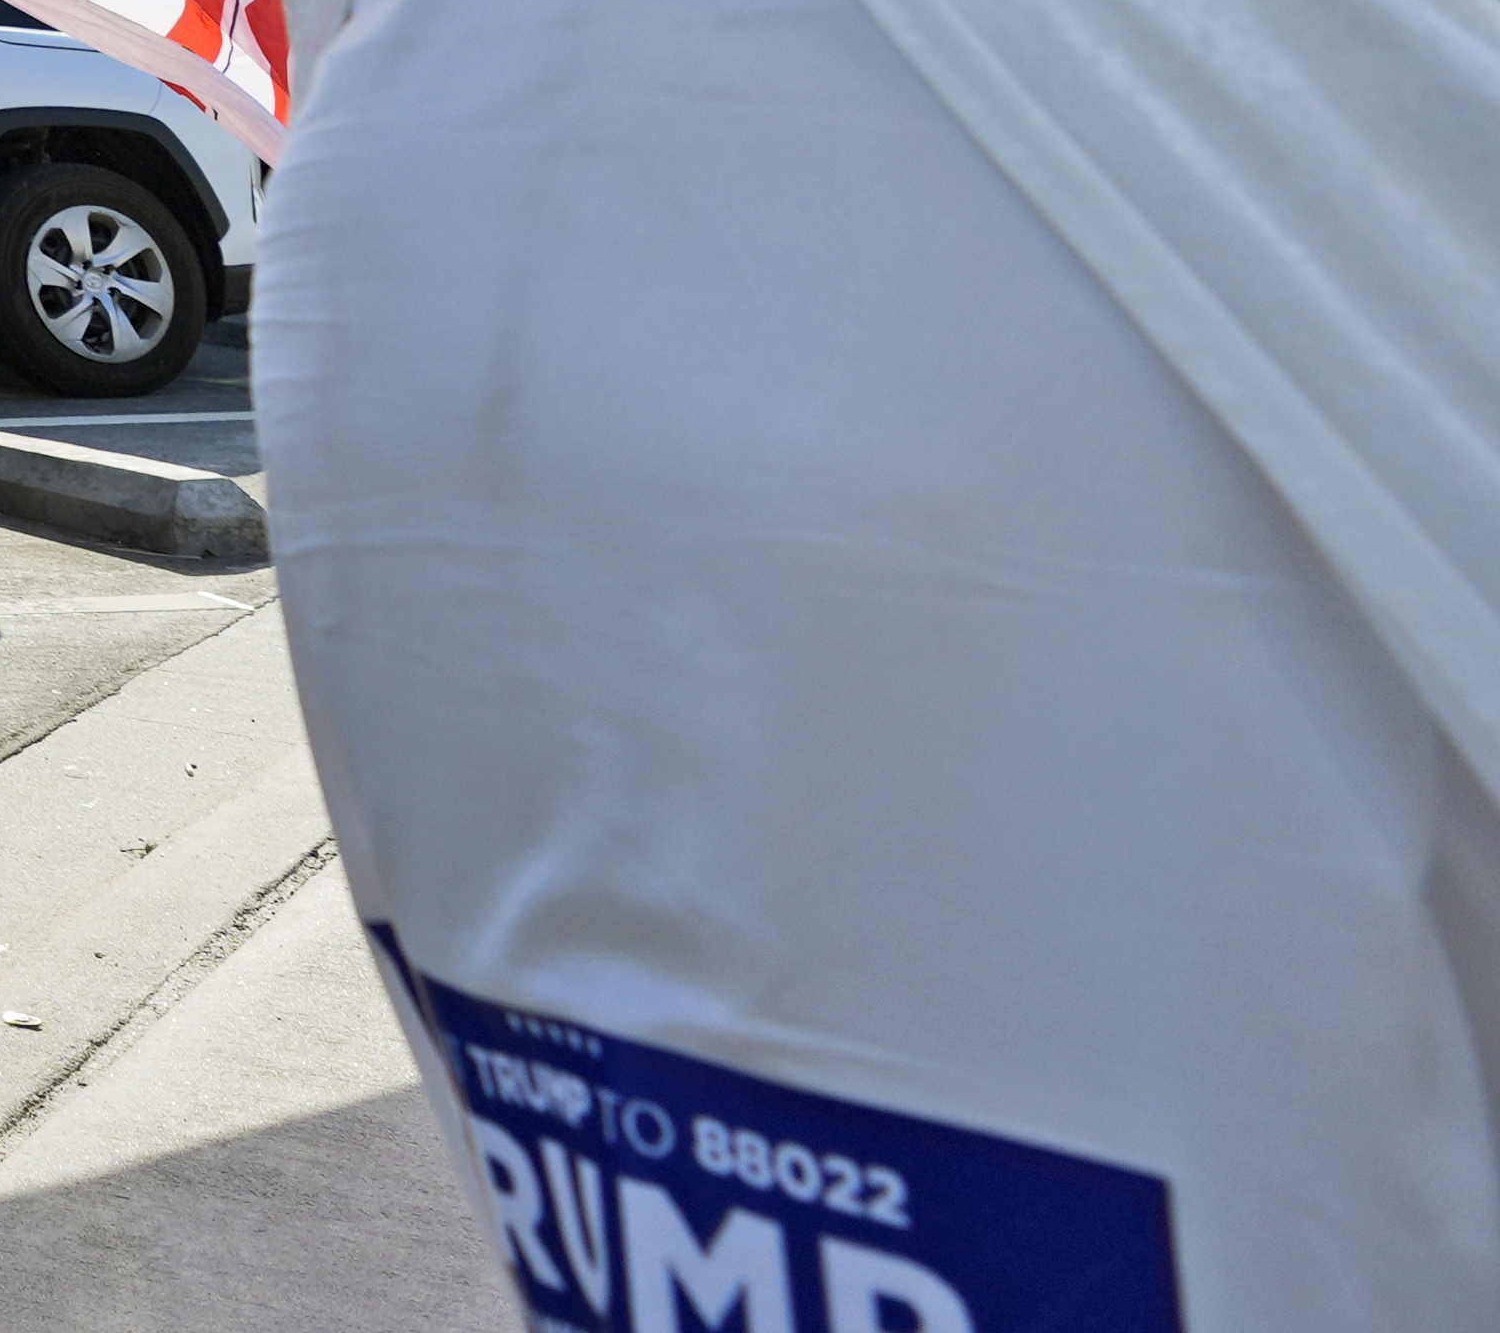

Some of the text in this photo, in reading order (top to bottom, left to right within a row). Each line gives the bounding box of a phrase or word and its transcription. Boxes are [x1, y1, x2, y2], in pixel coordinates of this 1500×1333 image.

[468, 1048, 595, 1128] TRUMP
[597, 1087, 677, 1157] TO
[693, 1116, 909, 1230] 88022
[472, 1118, 978, 1333] RUMP
